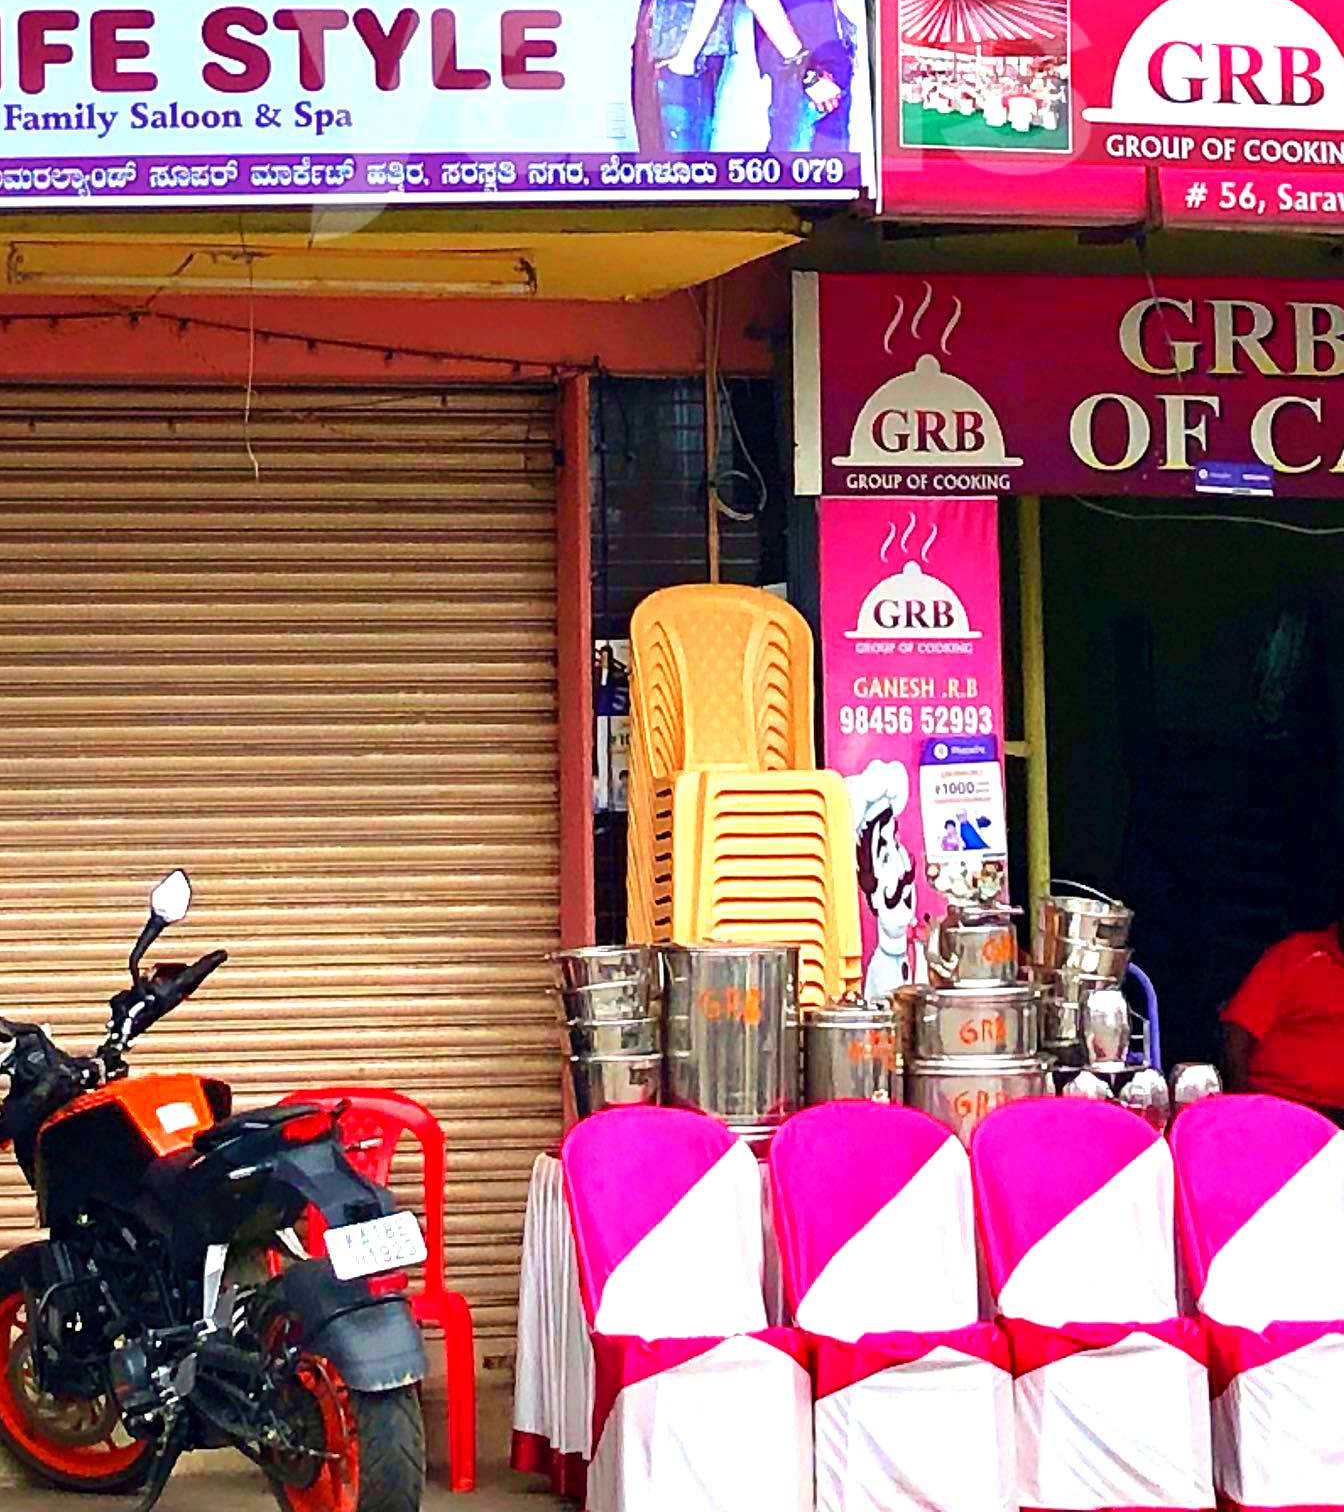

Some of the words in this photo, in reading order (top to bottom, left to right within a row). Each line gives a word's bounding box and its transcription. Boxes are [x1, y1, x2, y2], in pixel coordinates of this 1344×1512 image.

[202, 6, 565, 94] STYLE
[1147, 42, 1325, 106] GRB
[3, 103, 120, 139] Family
[130, 103, 244, 130] Saloon
[255, 102, 282, 128] &
[294, 101, 353, 136] Spa
[1106, 134, 1195, 159] GROUP
[1201, 136, 1234, 161] OF
[150, 159, 238, 188] ಸೂಪರ್
[600, 156, 717, 184] ಬೆಂಗಳೂರು
[728, 159, 780, 183] 560
[791, 158, 844, 183] 079
[1185, 183, 1207, 210] #
[1218, 181, 1266, 214] 56,
[871, 409, 985, 453] GRB
[1069, 392, 1220, 472] OF
[846, 473, 902, 490] GROUP
[907, 473, 928, 490] OF
[933, 472, 1010, 491] COOKING
[873, 599, 954, 629] GRB
[853, 676, 934, 699] GANESH
[840, 705, 912, 735] 98456
[920, 705, 992, 735] 52993
